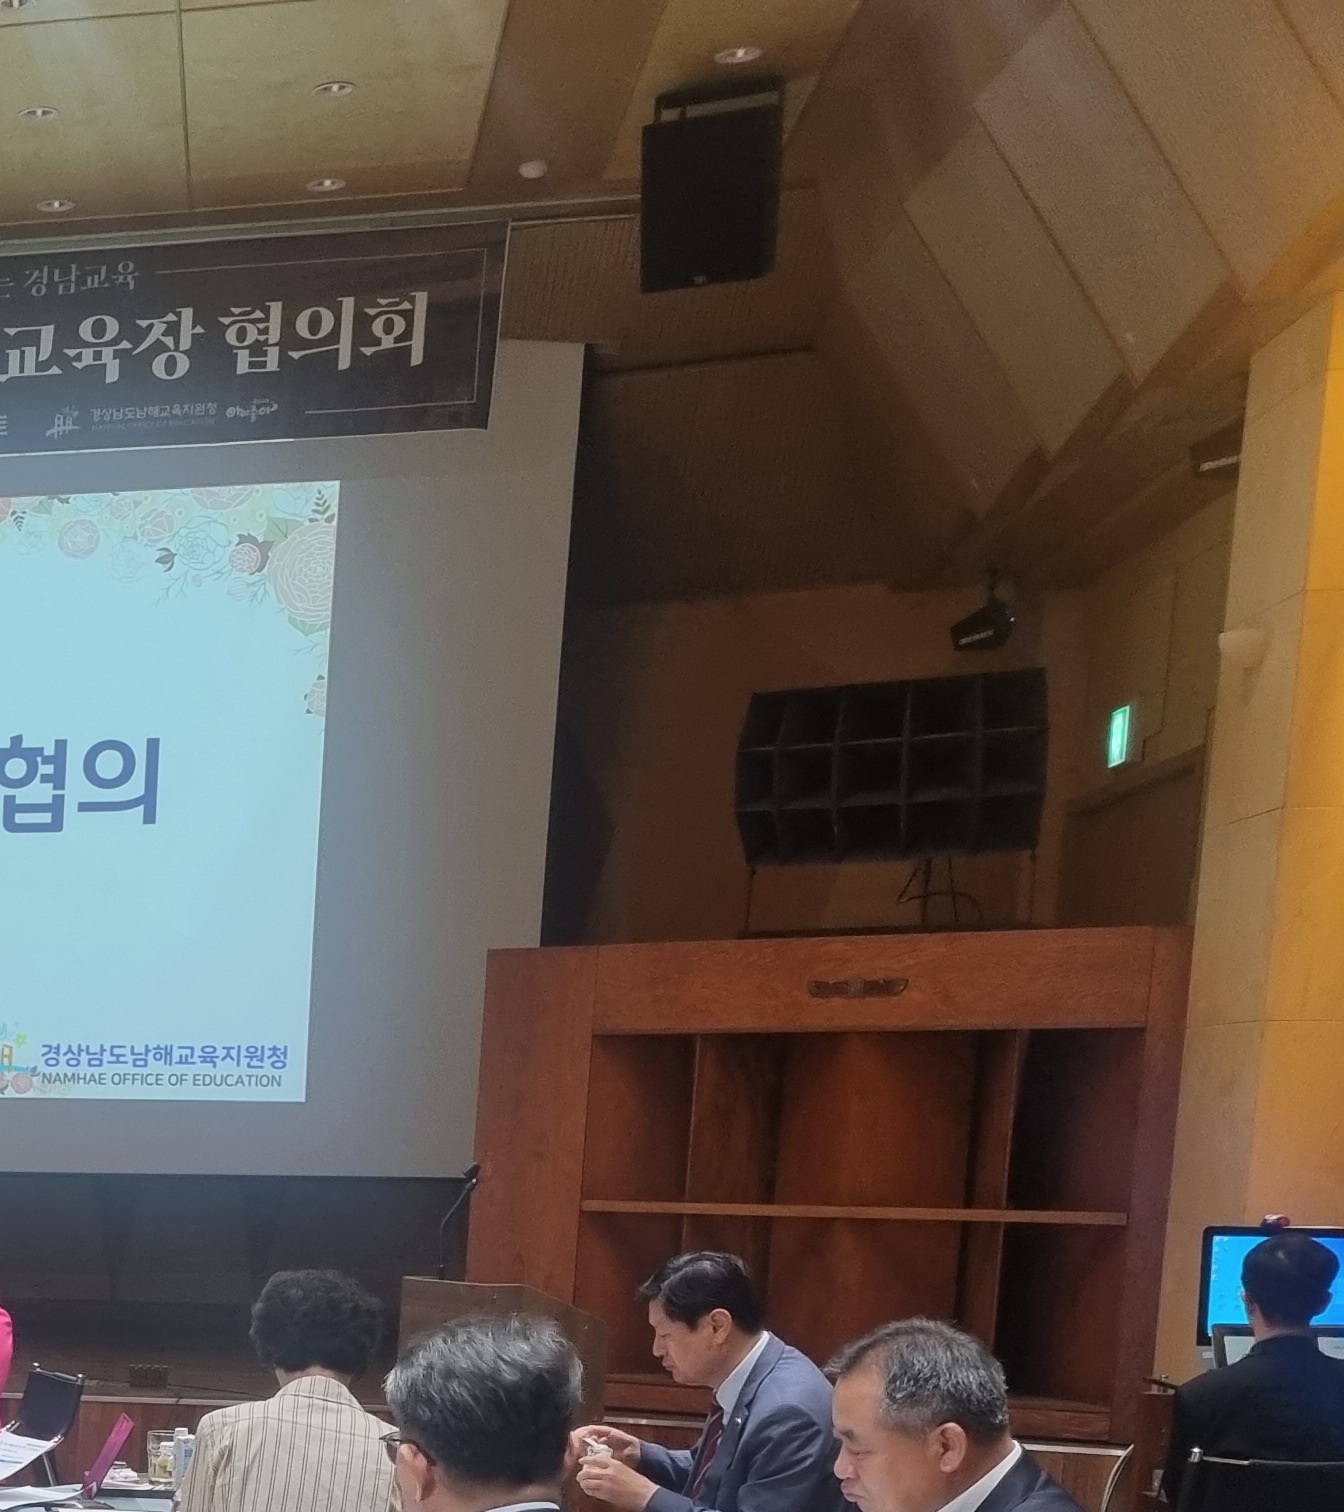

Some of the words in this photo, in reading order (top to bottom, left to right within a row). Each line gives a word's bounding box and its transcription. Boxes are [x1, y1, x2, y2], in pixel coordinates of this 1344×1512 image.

[23, 260, 141, 297] 경남교육
[217, 291, 429, 375] 협의회
[40, 1043, 289, 1070] 경상남도남해교육지원청
[41, 1071, 107, 1086] NAMHAE
[111, 1072, 165, 1087] OFFICE
[167, 1073, 189, 1087] OF
[192, 1073, 283, 1088] EDUCATION
